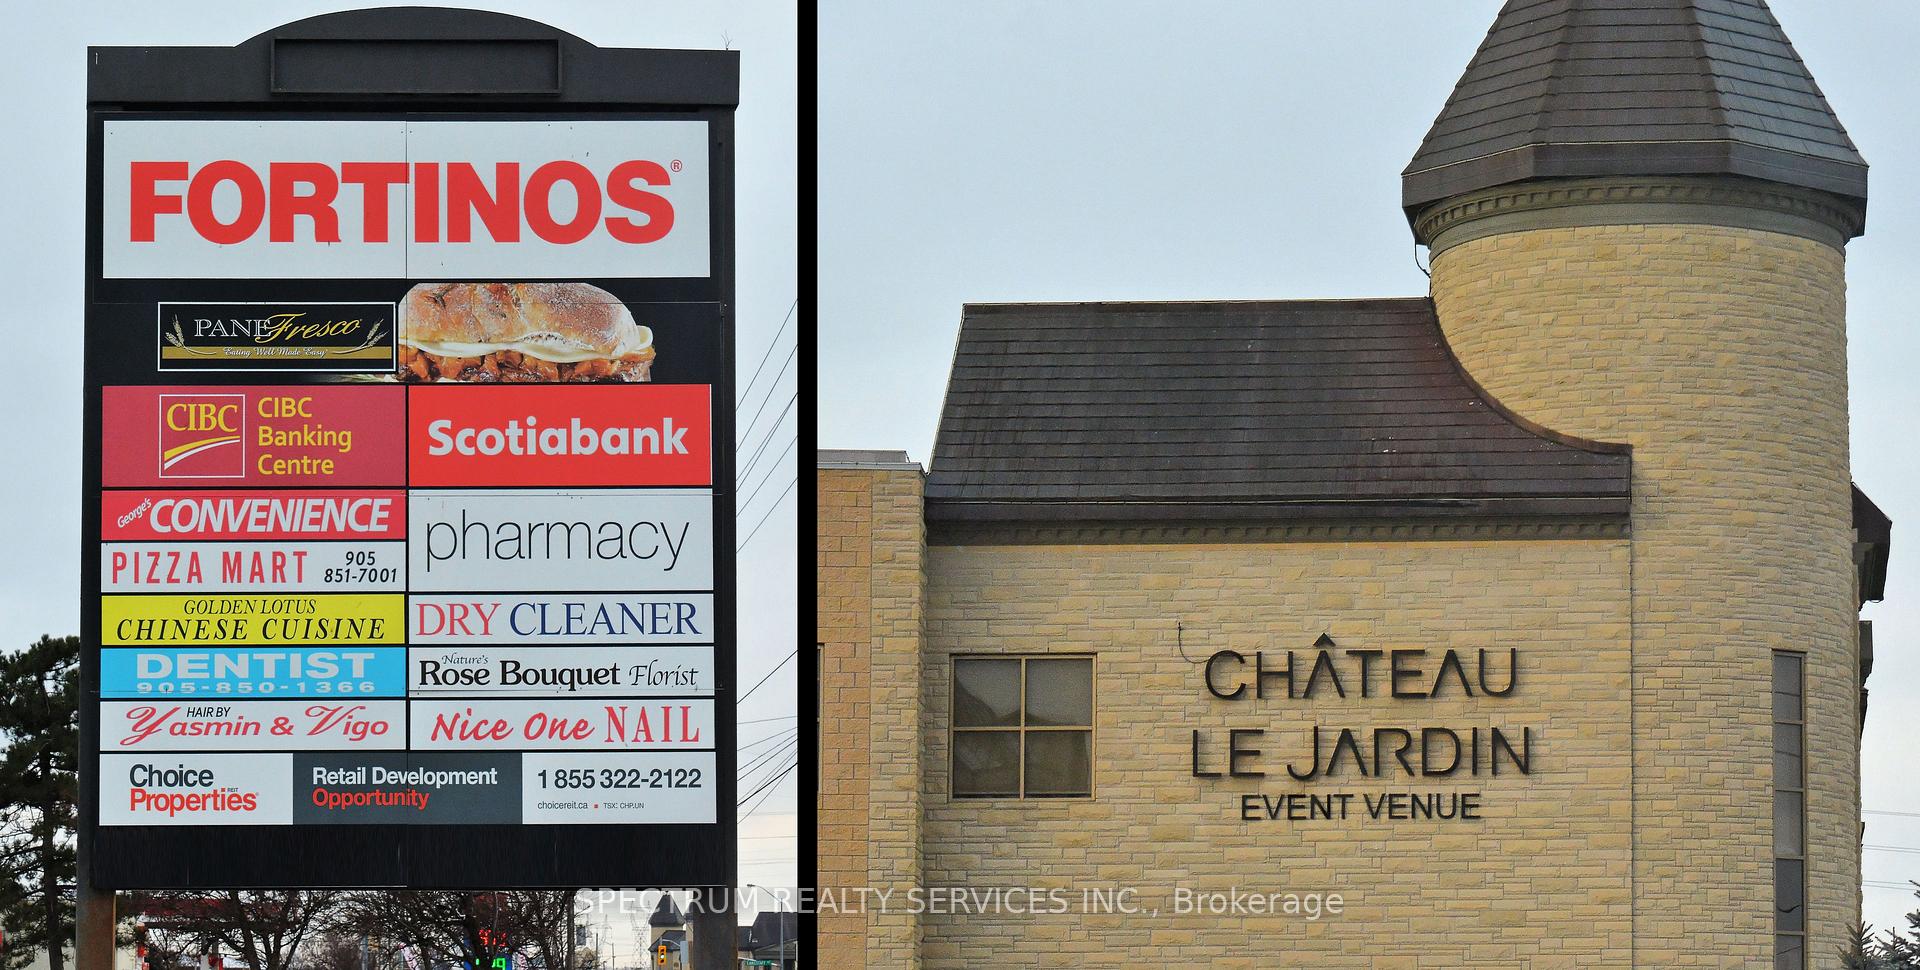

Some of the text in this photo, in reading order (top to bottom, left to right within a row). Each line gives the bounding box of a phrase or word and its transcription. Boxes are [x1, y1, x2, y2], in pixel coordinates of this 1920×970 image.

[130, 160, 675, 245] FORTINOS
[223, 347, 326, 358] Eating Well Made Easy
[166, 403, 238, 432] CIBC
[257, 397, 313, 419] CIBC
[257, 424, 352, 453] Banking
[428, 415, 689, 456] Scotiabank
[257, 454, 334, 475] Centre
[117, 497, 392, 533] George's CONVENIENCE
[426, 508, 690, 573] pharmacy
[112, 551, 308, 584] PIZZA MART
[345, 551, 376, 566] 905
[323, 568, 397, 584] 851-7001
[184, 599, 317, 616] GOLDEN LOTUS
[415, 602, 702, 636] DRY CLEANER
[116, 617, 385, 641] CHINESE CUISINE
[136, 652, 375, 679] DENTIST
[441, 653, 489, 665] Nature's
[1204, 632, 1516, 699] CHÂTEAU
[136, 681, 376, 694] 905-850-1366
[419, 659, 699, 692] Rose Bouquet Florist
[119, 705, 389, 746] Yasmin & Vigo
[186, 706, 231, 718] HAIR BY
[430, 706, 700, 743] Nice One NAIL
[1192, 725, 1530, 781] LE JARDIN
[129, 763, 214, 788] Choice
[312, 766, 498, 789] Retail Development
[554, 768, 596, 789] 855
[599, 768, 702, 789] 322-2122
[130, 787, 257, 818] Properties
[312, 787, 430, 810] Opportunity
[537, 800, 588, 810] choicereit.ca
[1241, 792, 1481, 821] EVENT VENUE
